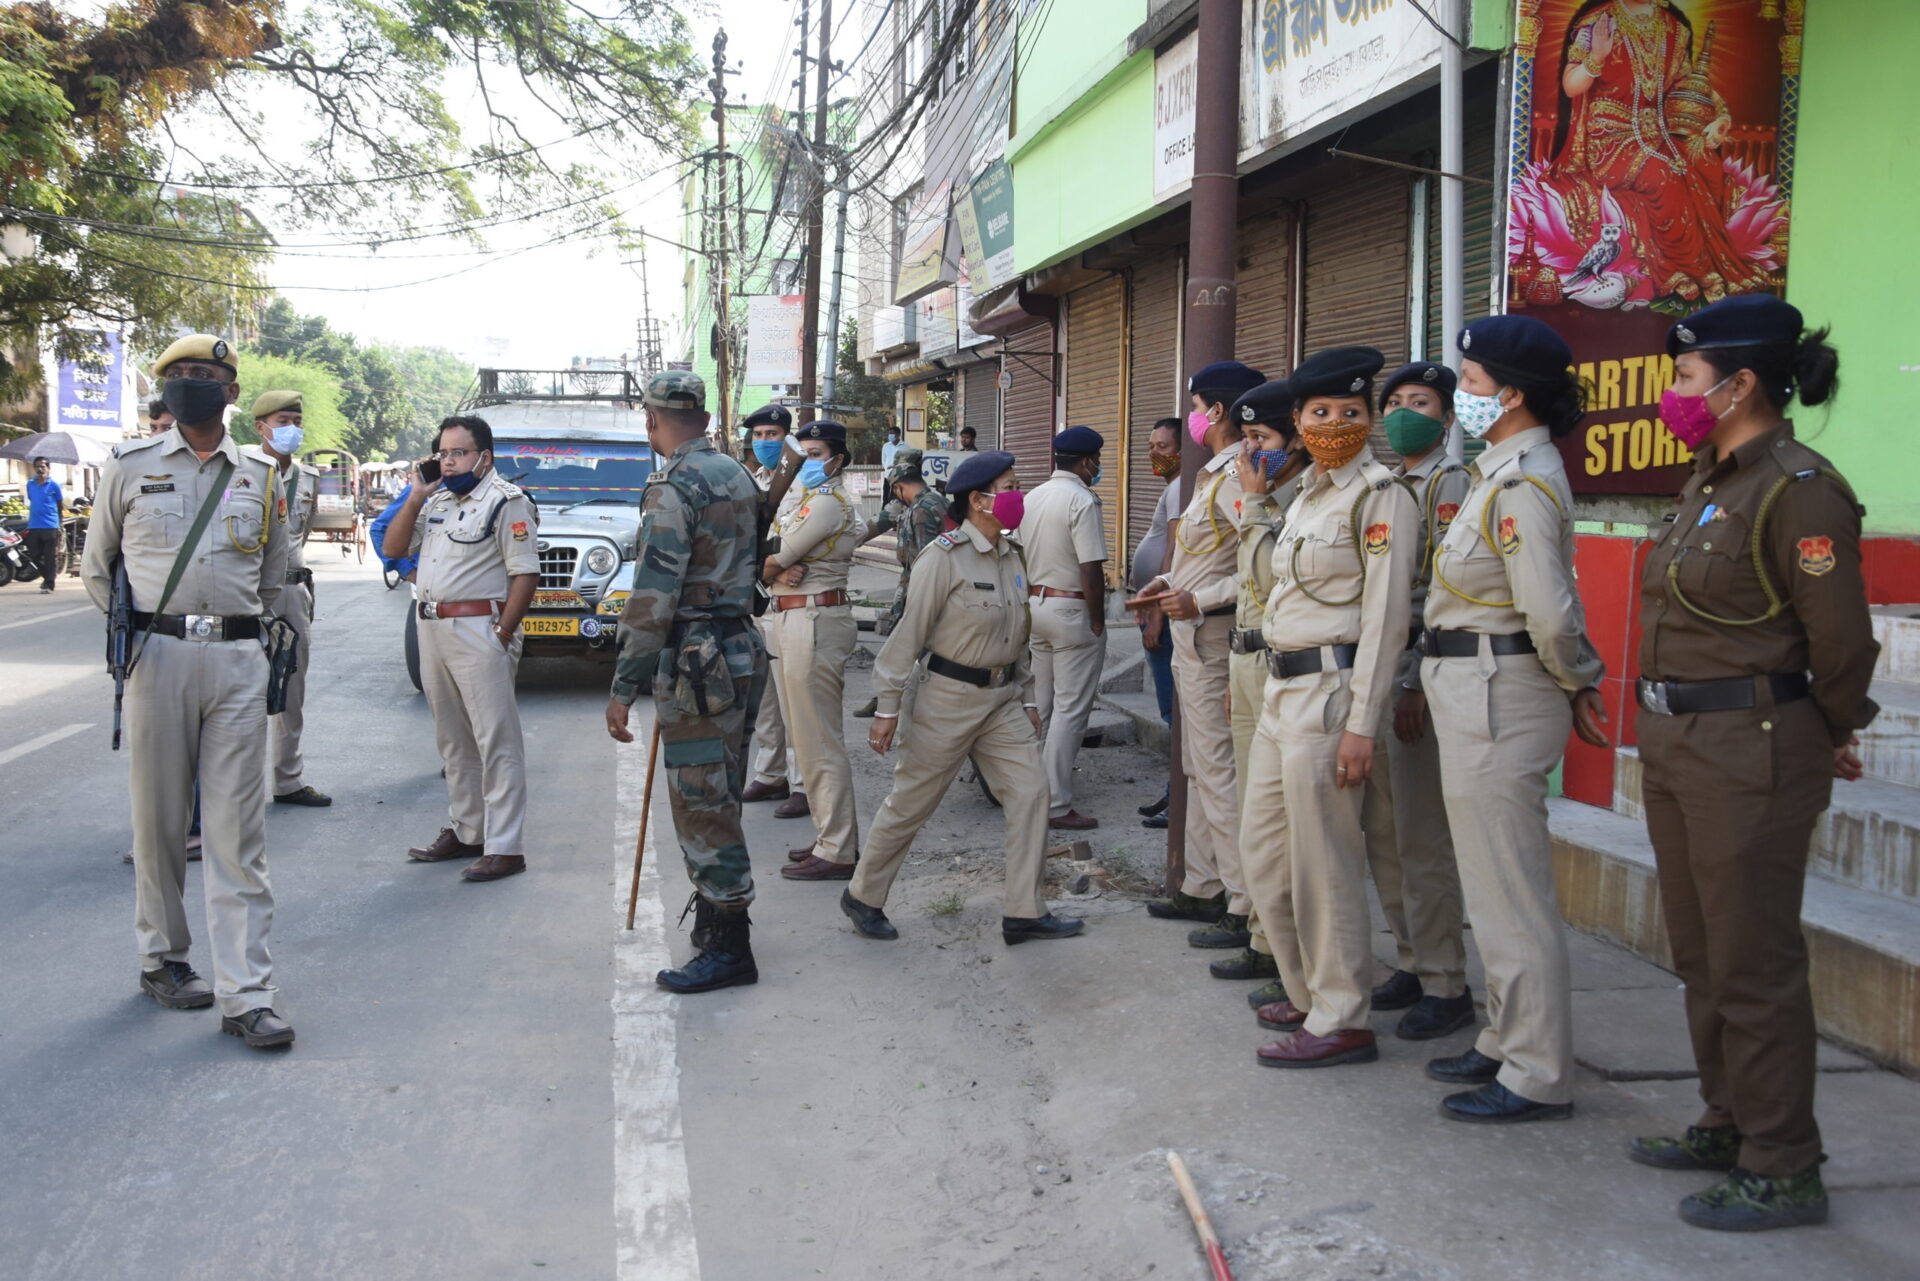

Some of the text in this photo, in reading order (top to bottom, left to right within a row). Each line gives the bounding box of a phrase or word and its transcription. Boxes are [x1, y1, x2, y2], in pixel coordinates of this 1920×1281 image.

[1164, 137, 1186, 165] OFFICE
[1566, 353, 1675, 412] ARTM
[521, 620, 572, 633] 01B2975
